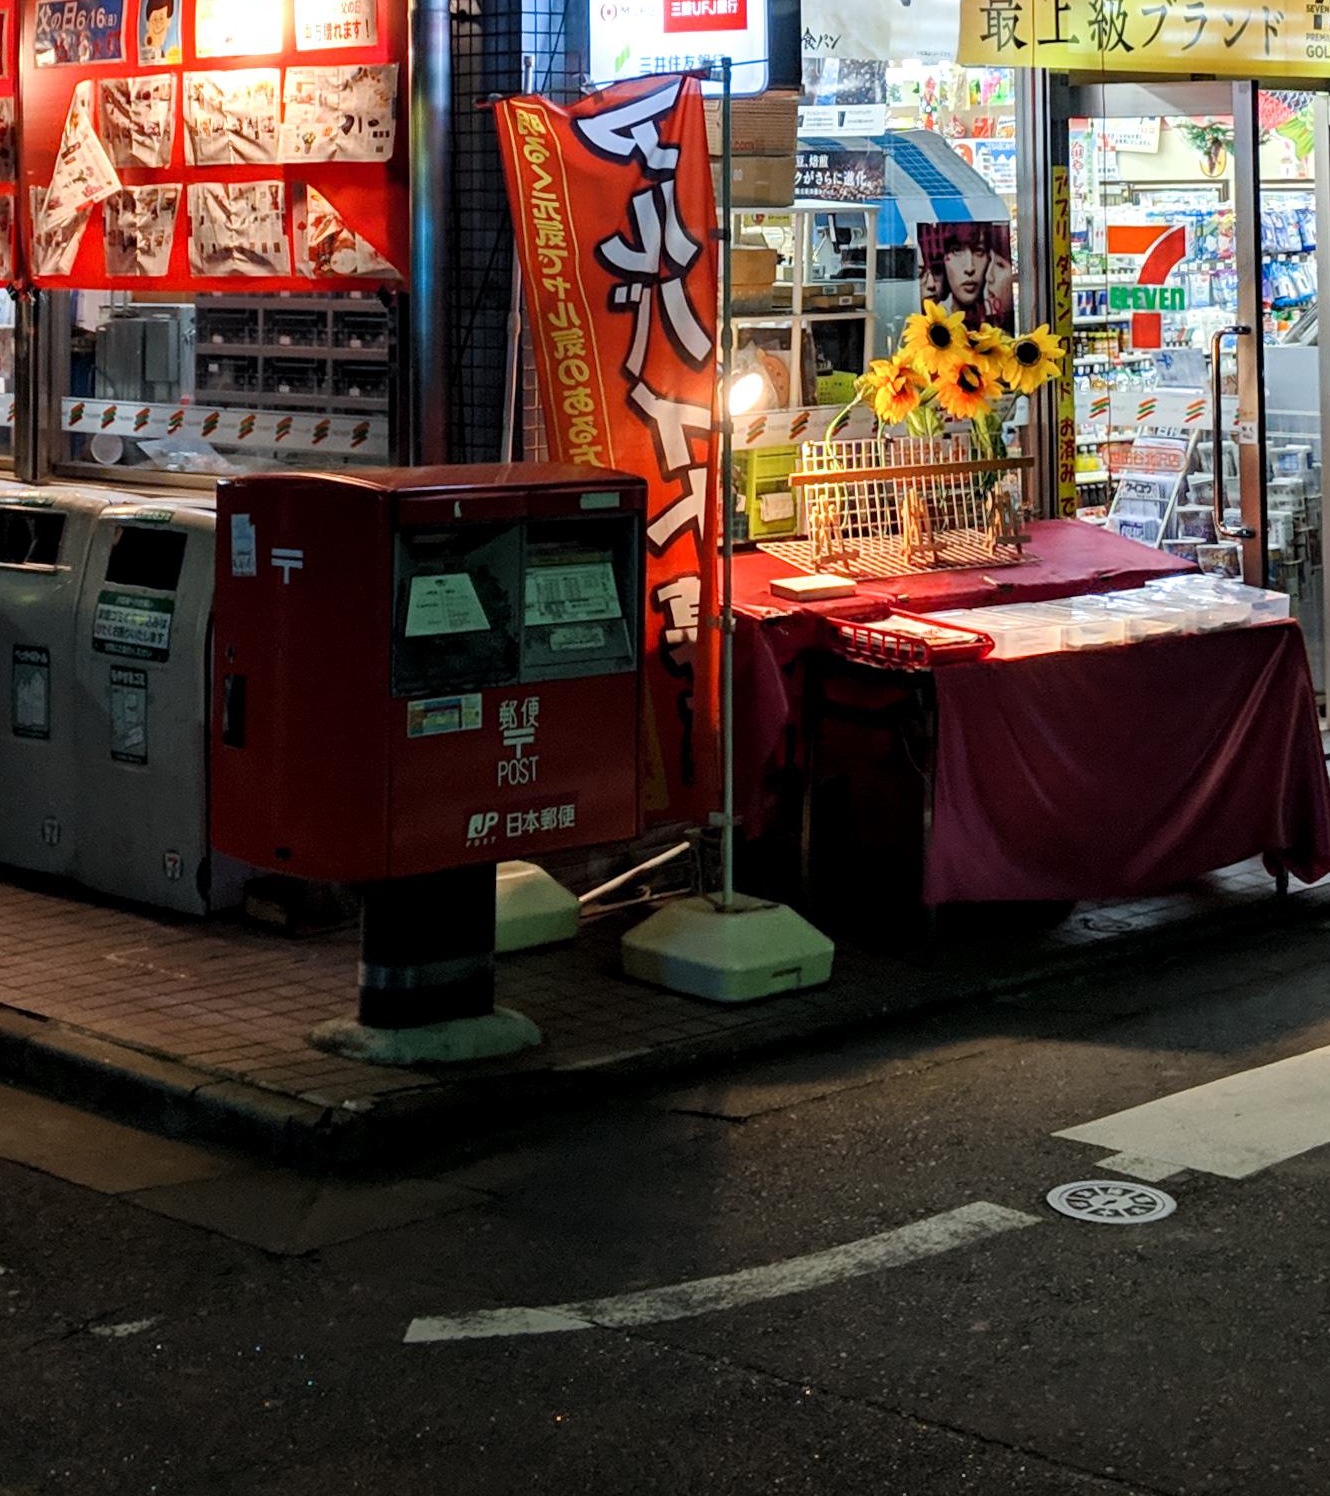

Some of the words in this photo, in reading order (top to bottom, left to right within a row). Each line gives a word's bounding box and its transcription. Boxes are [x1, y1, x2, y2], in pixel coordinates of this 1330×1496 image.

[498, 695, 541, 729] 郵便
[497, 756, 540, 787] POST
[506, 804, 576, 838] 日本郵便
